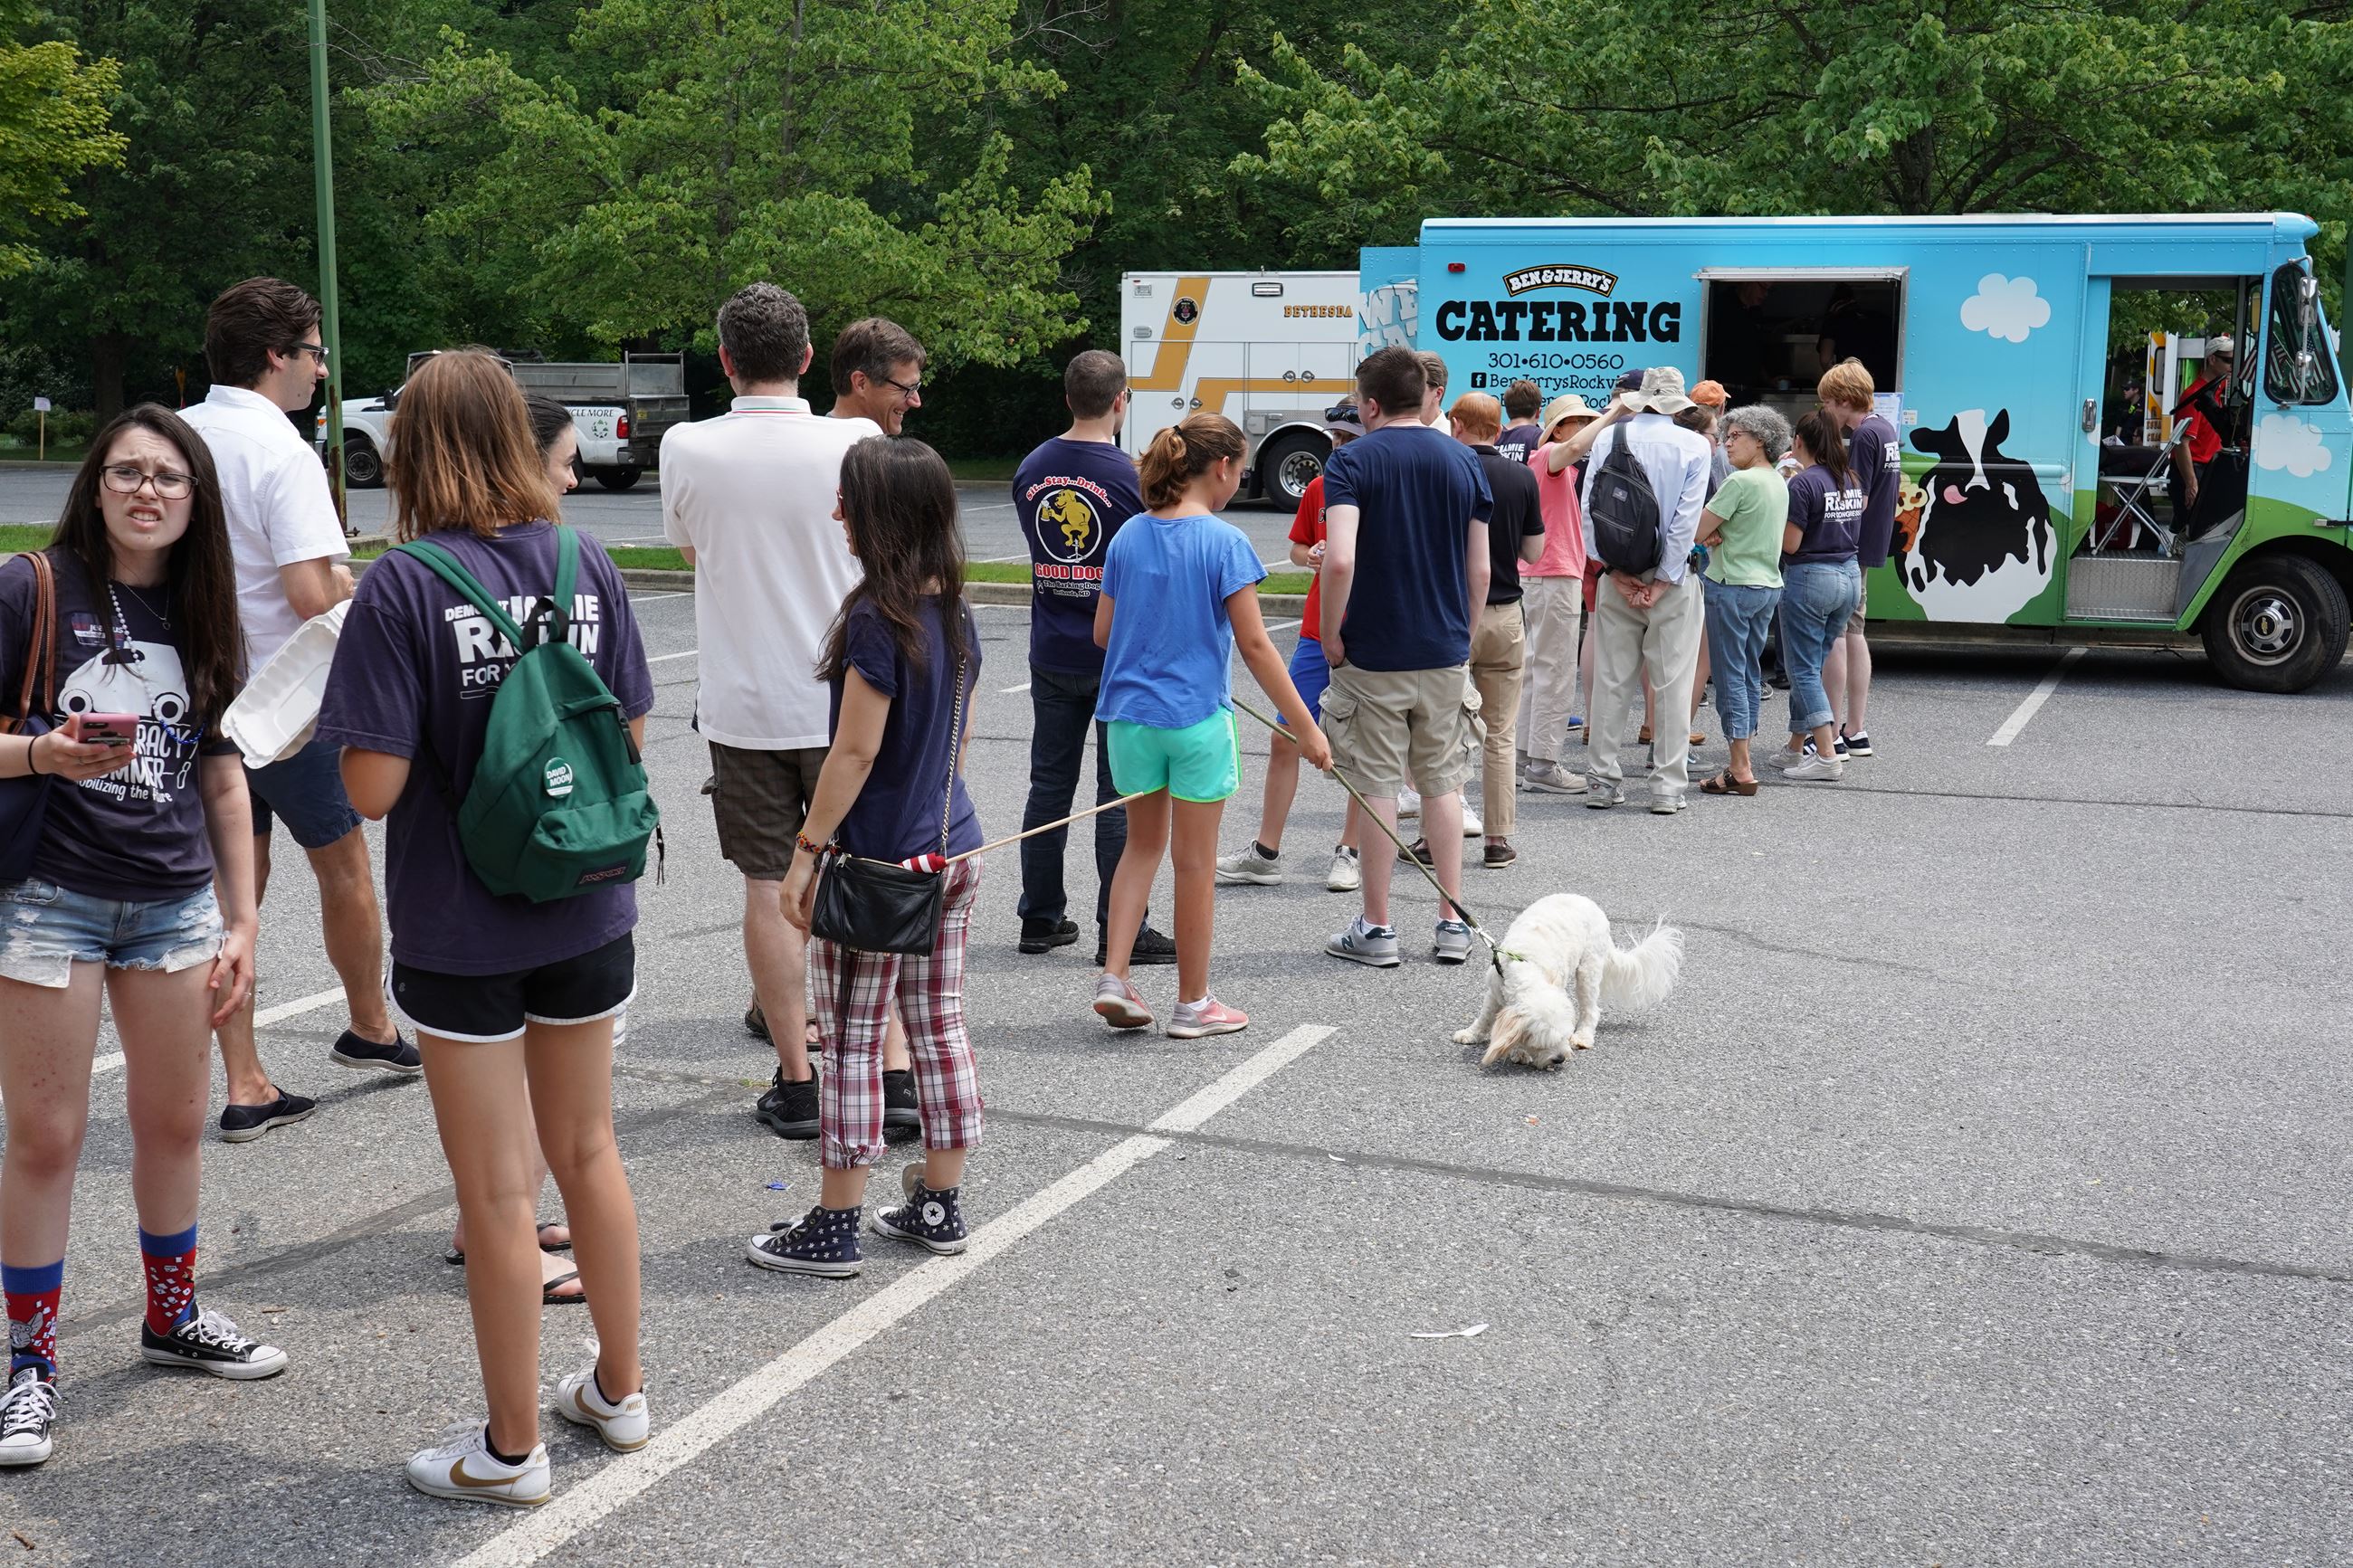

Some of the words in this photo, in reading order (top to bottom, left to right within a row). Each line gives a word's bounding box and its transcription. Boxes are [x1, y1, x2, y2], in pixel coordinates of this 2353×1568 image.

[1283, 305, 1353, 318] BETHESDA
[1435, 299, 1681, 343] CATERING
[586, 408, 614, 418] MORE
[1824, 498, 1862, 512] RASKIN
[1034, 562, 1070, 578] GOOD
[1043, 579, 1056, 588] The
[1055, 581, 1084, 591] Barking
[1084, 582, 1101, 591] Dog
[461, 663, 501, 687] FOR
[546, 766, 567, 779] DAVID
[549, 774, 570, 787] MOON
[130, 784, 149, 800] the
[624, 1400, 643, 1412] NIKE
